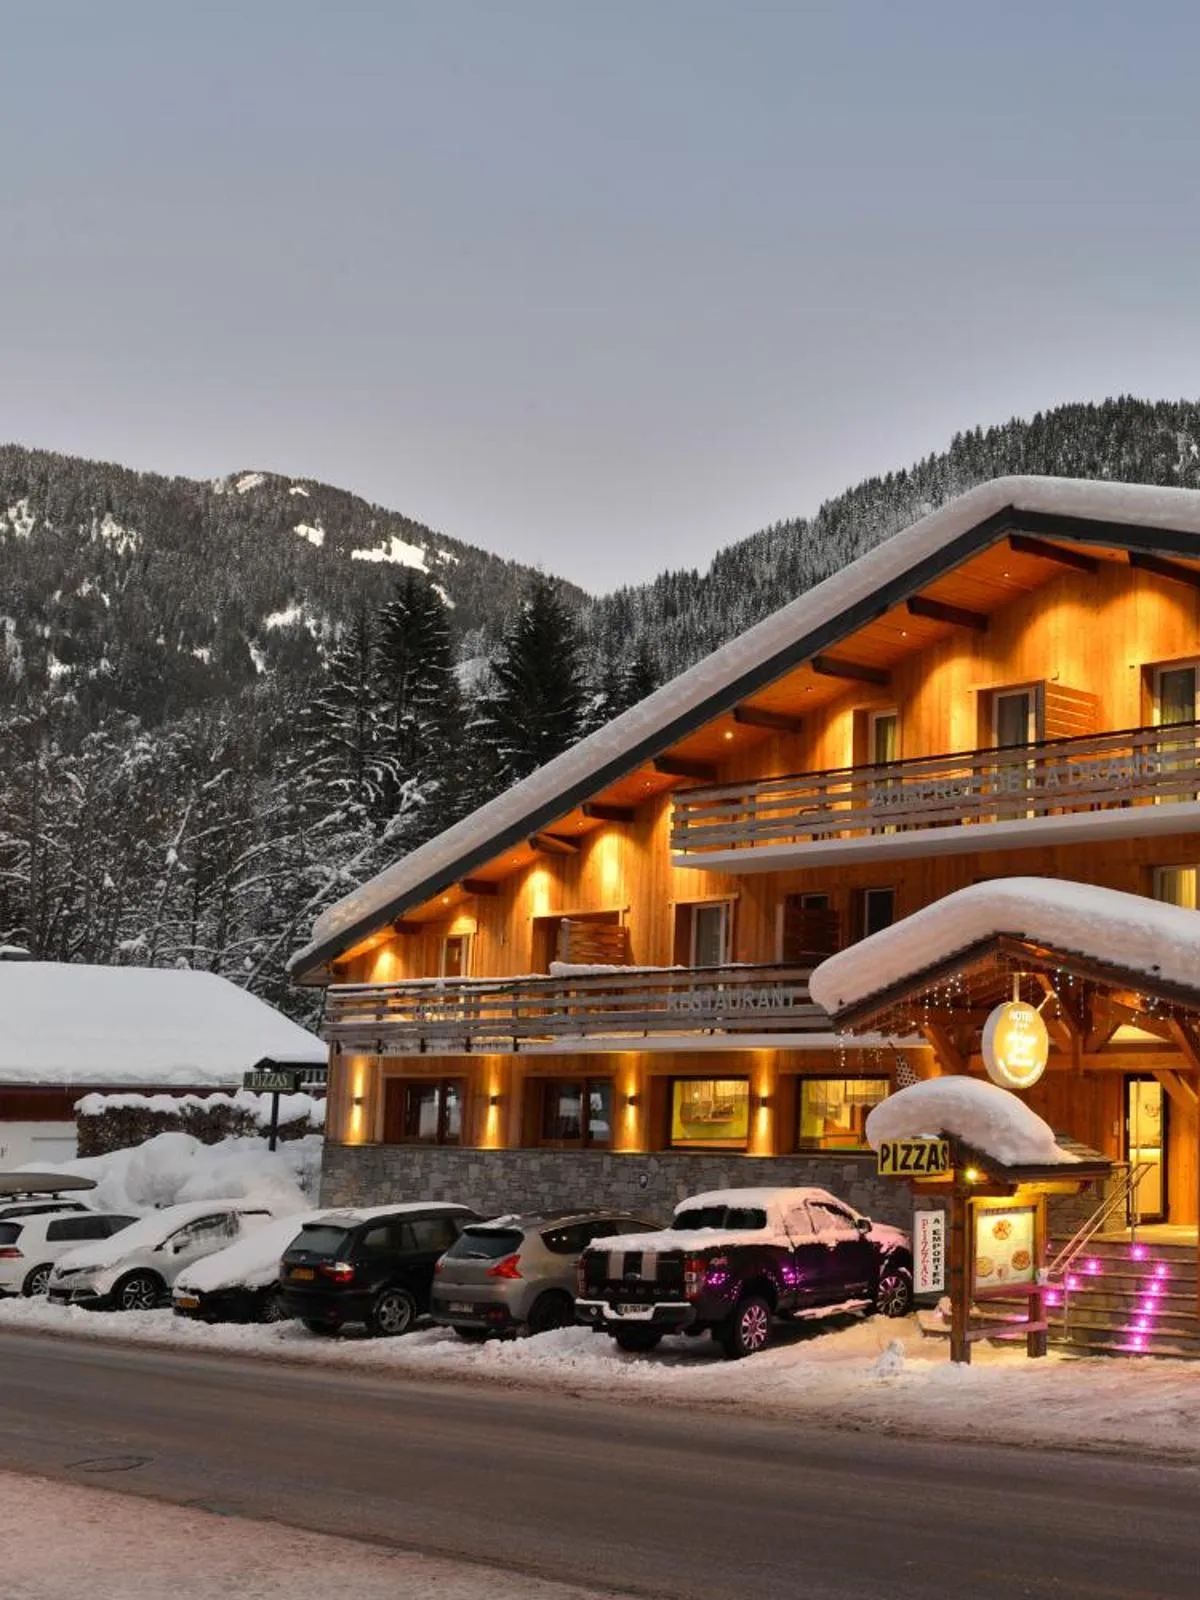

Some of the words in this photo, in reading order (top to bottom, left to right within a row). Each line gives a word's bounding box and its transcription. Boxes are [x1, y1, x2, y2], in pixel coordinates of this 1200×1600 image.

[667, 986, 795, 1012] RESTAURANT
[250, 1072, 288, 1088] PIZZAS
[881, 1142, 948, 1172] PIZZAS
[921, 1218, 929, 1288] PIZZAS
[932, 1228, 941, 1286] EMPORTER
